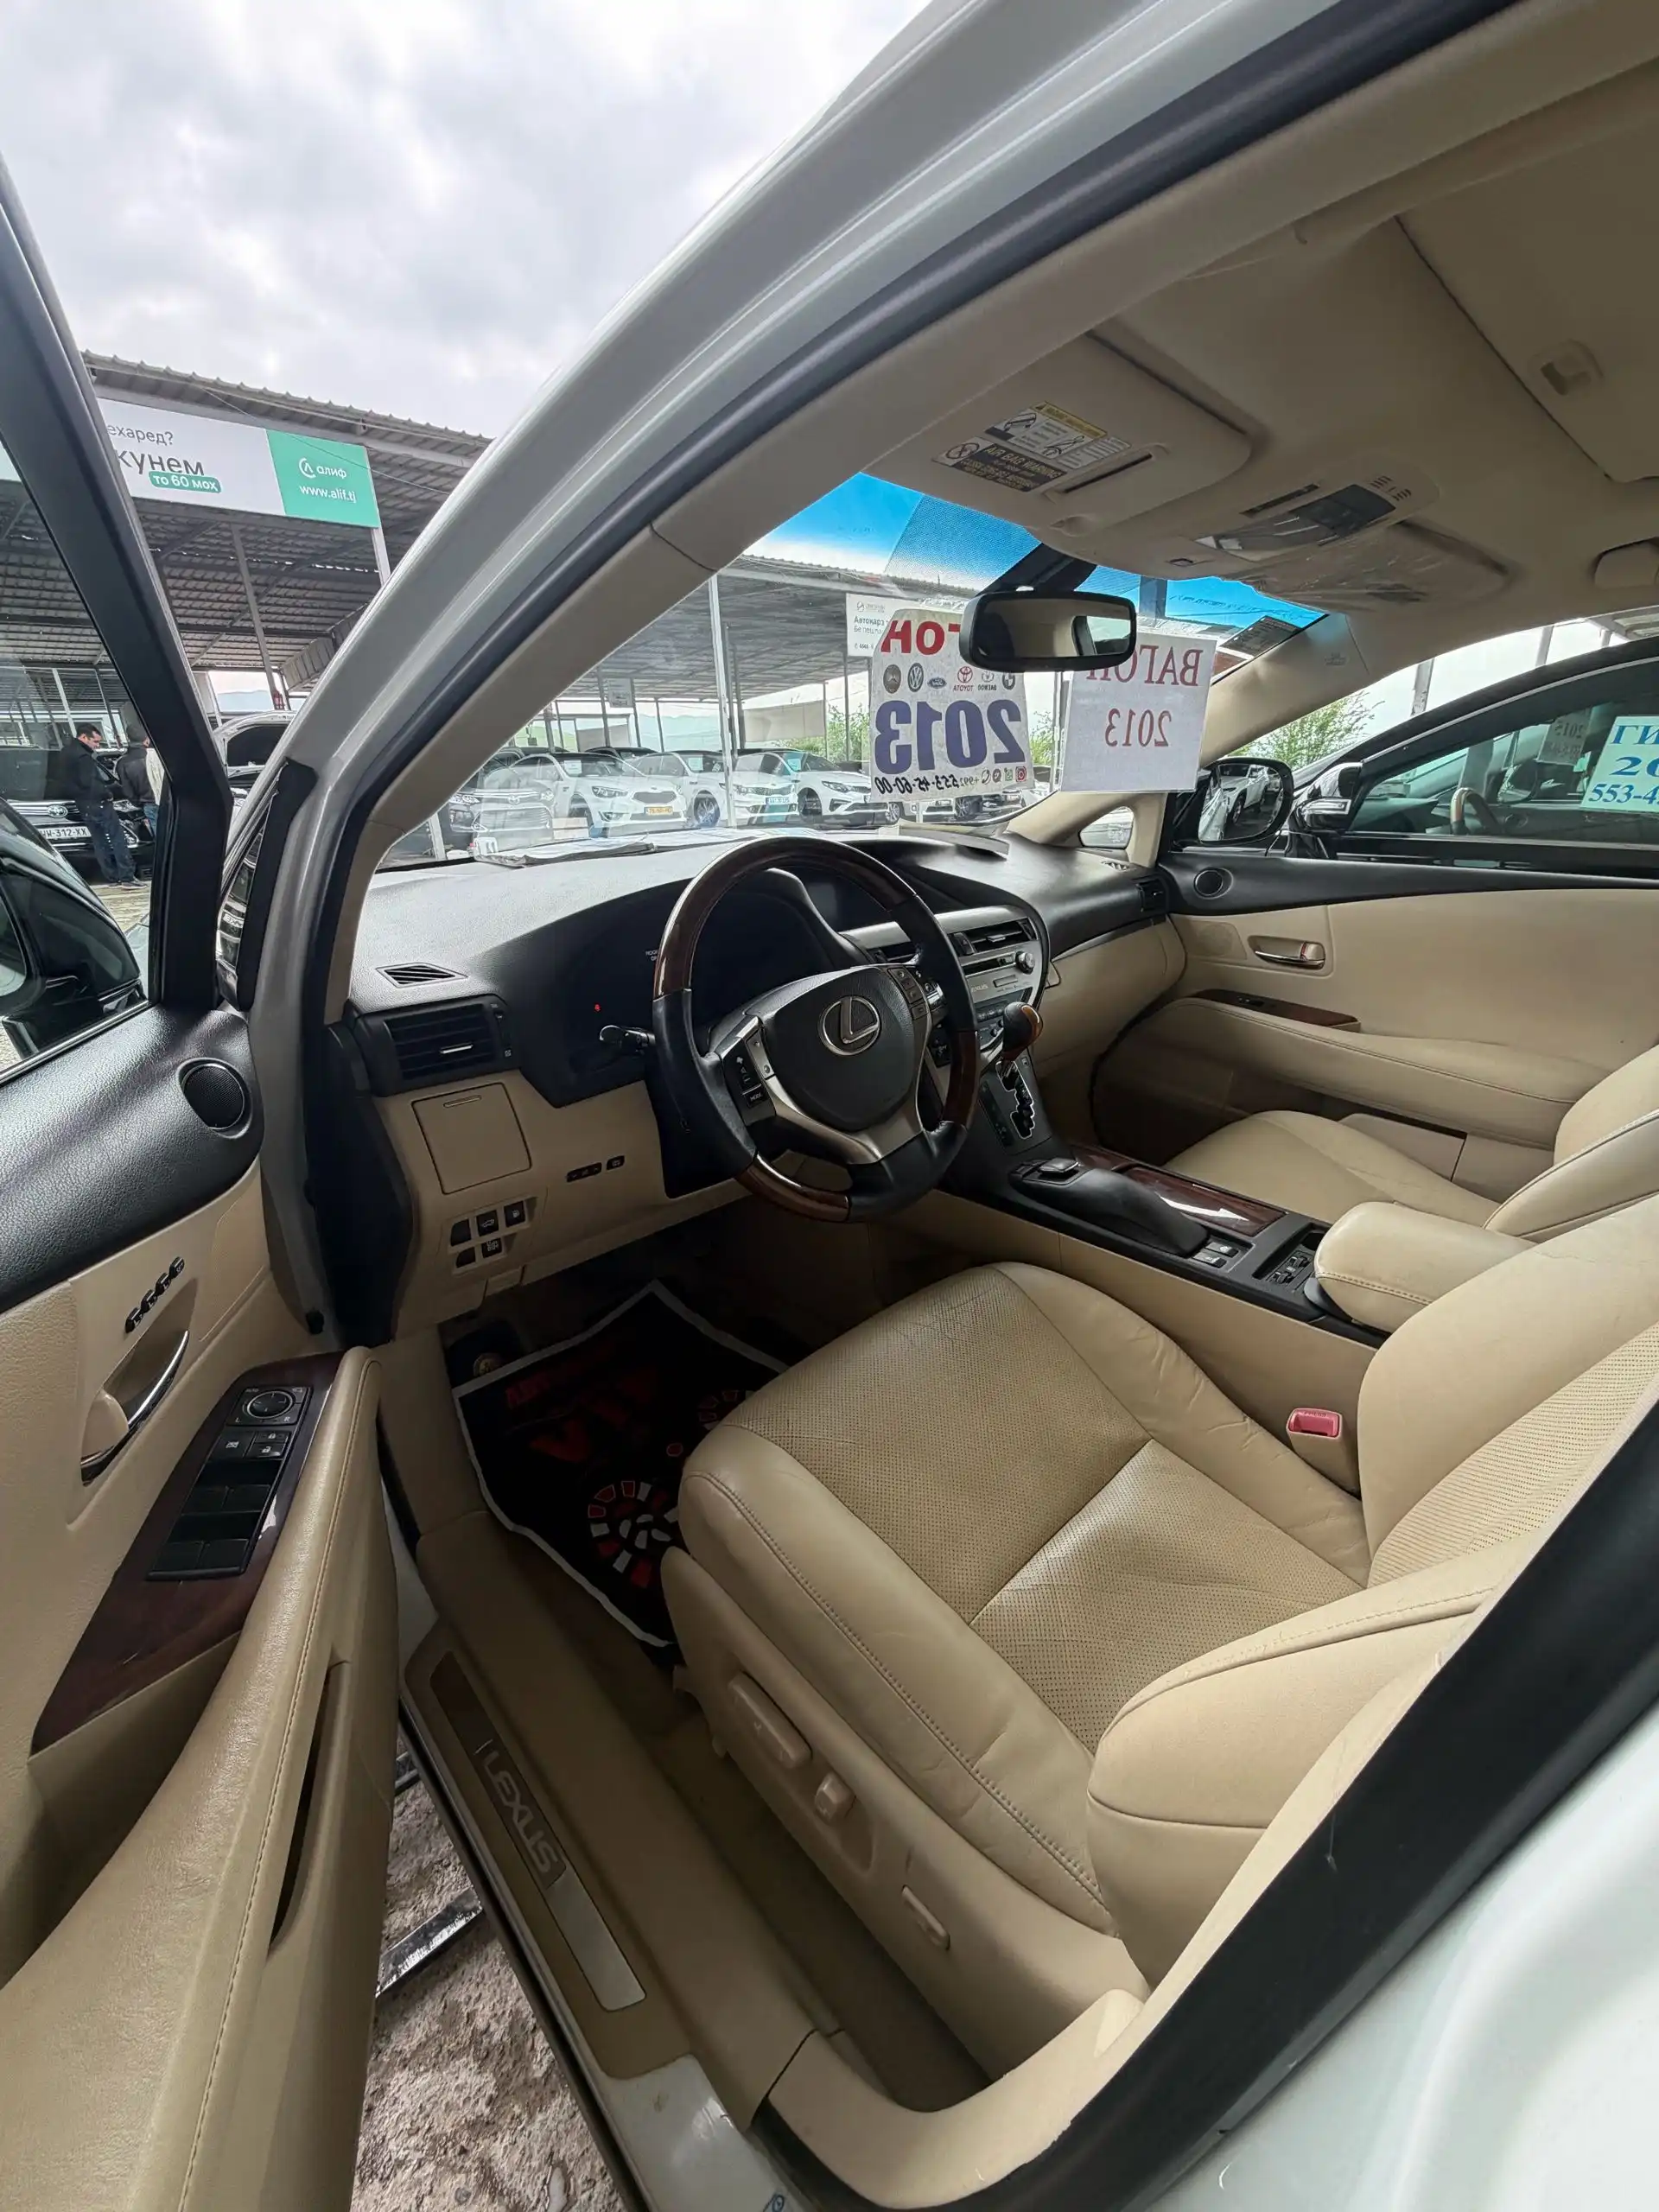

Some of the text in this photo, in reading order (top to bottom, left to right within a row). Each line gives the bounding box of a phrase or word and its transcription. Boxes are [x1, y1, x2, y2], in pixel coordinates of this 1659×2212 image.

[316, 466, 347, 480] алиф
[153, 475, 219, 493] то 60 мох
[300, 485, 357, 503] www.alif.tj
[1588, 783, 1659, 804] 553-4
[482, 1751, 559, 1873] LEXUS
